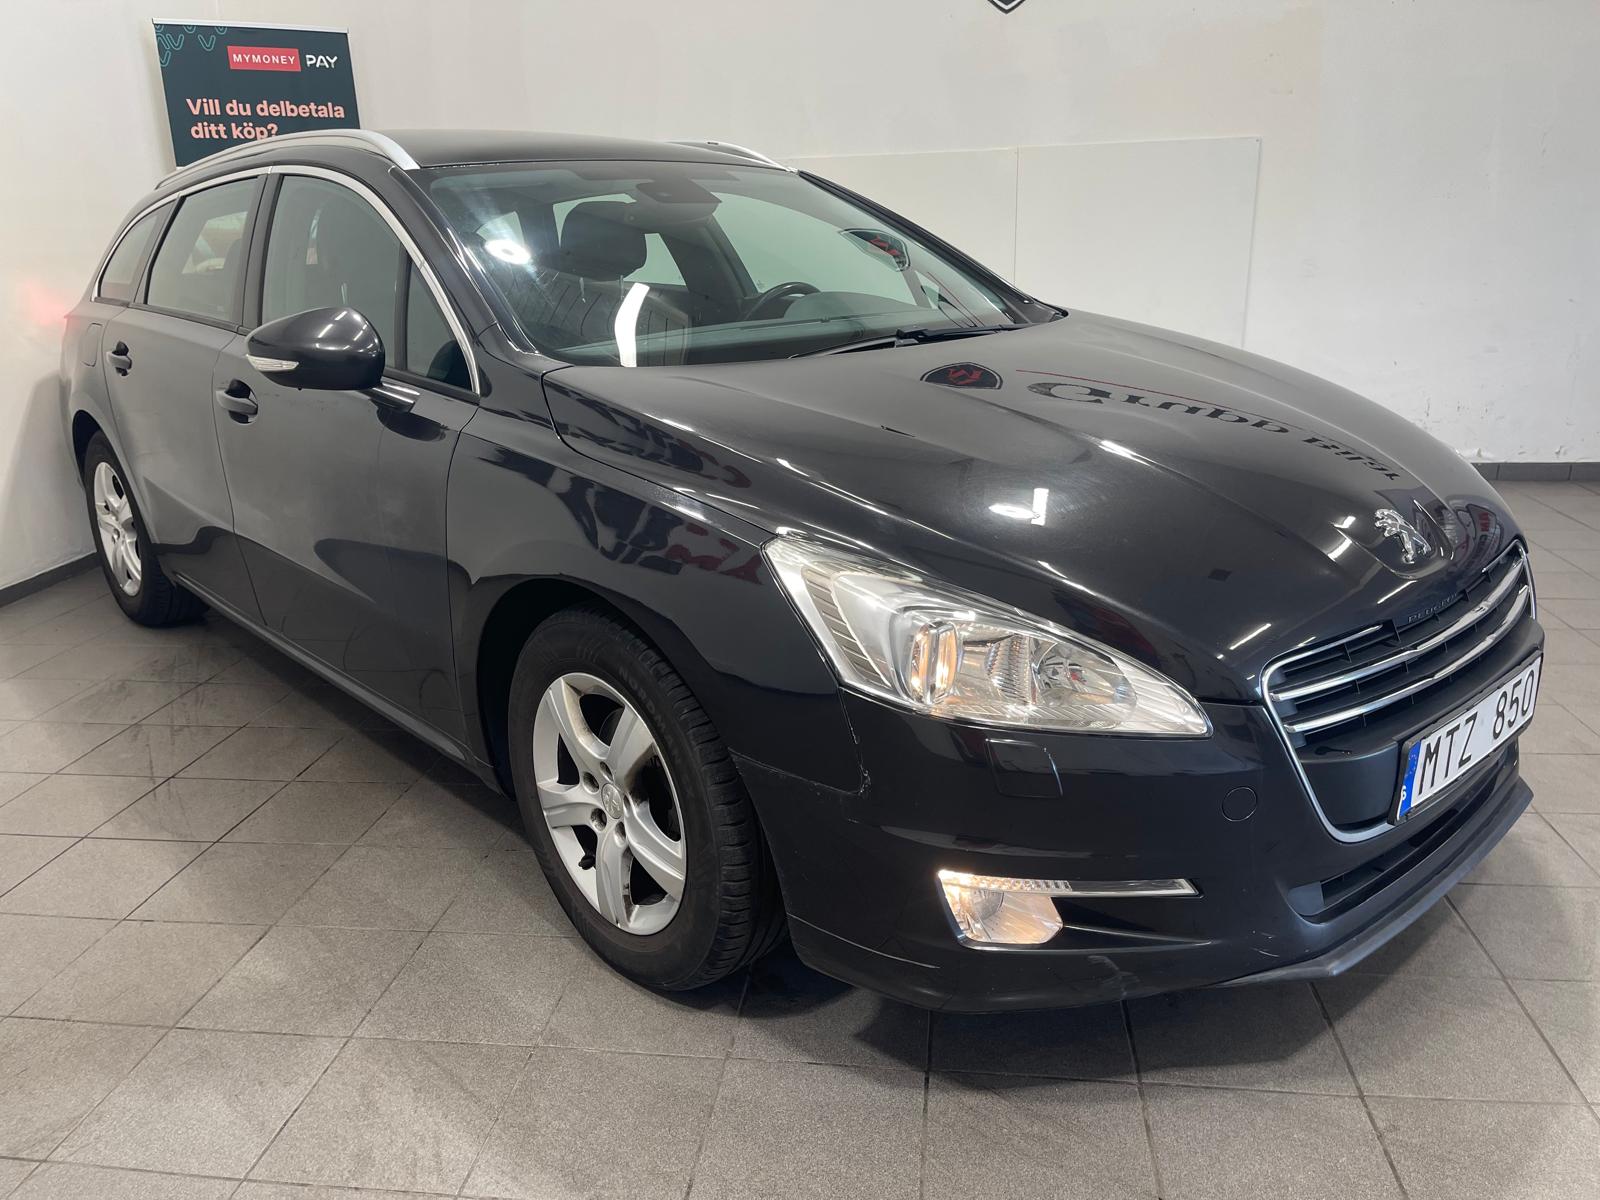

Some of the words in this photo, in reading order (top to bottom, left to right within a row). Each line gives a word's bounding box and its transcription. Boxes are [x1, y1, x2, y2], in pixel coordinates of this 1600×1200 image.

[232, 53, 295, 65] MYMONEY
[305, 54, 338, 68] PAY
[186, 98, 220, 116] Vill
[225, 99, 252, 116] du
[256, 100, 345, 118] delbetala
[190, 121, 228, 139] ditt
[231, 123, 278, 141] köp?
[1417, 711, 1478, 796] MTZ
[1492, 669, 1535, 740] 850
